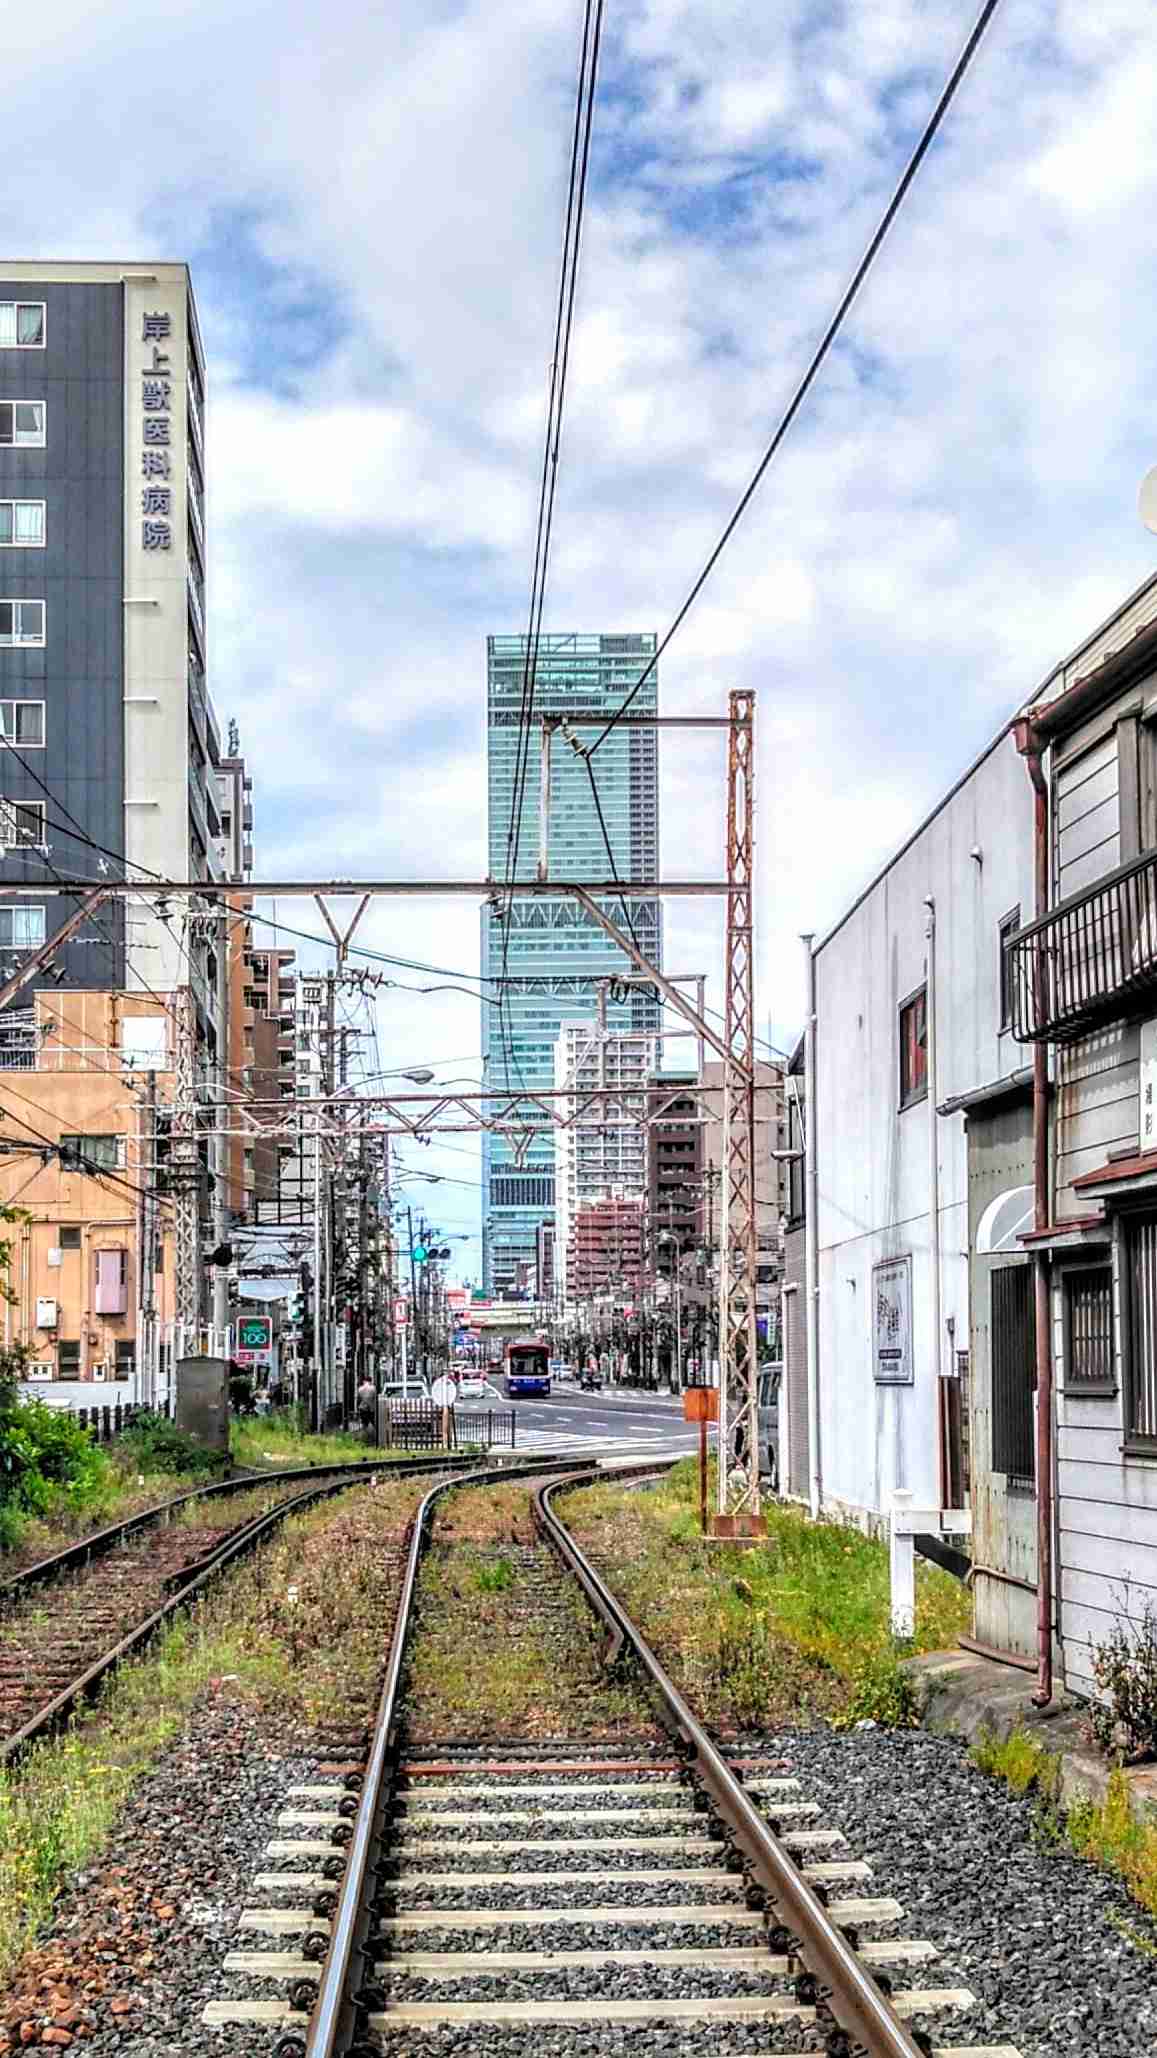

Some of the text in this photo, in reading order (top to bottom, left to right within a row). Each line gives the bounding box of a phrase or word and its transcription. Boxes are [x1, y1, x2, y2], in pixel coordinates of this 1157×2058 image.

[142, 311, 171, 550] 岸上獣医科病院
[243, 1332, 267, 1344] 100
